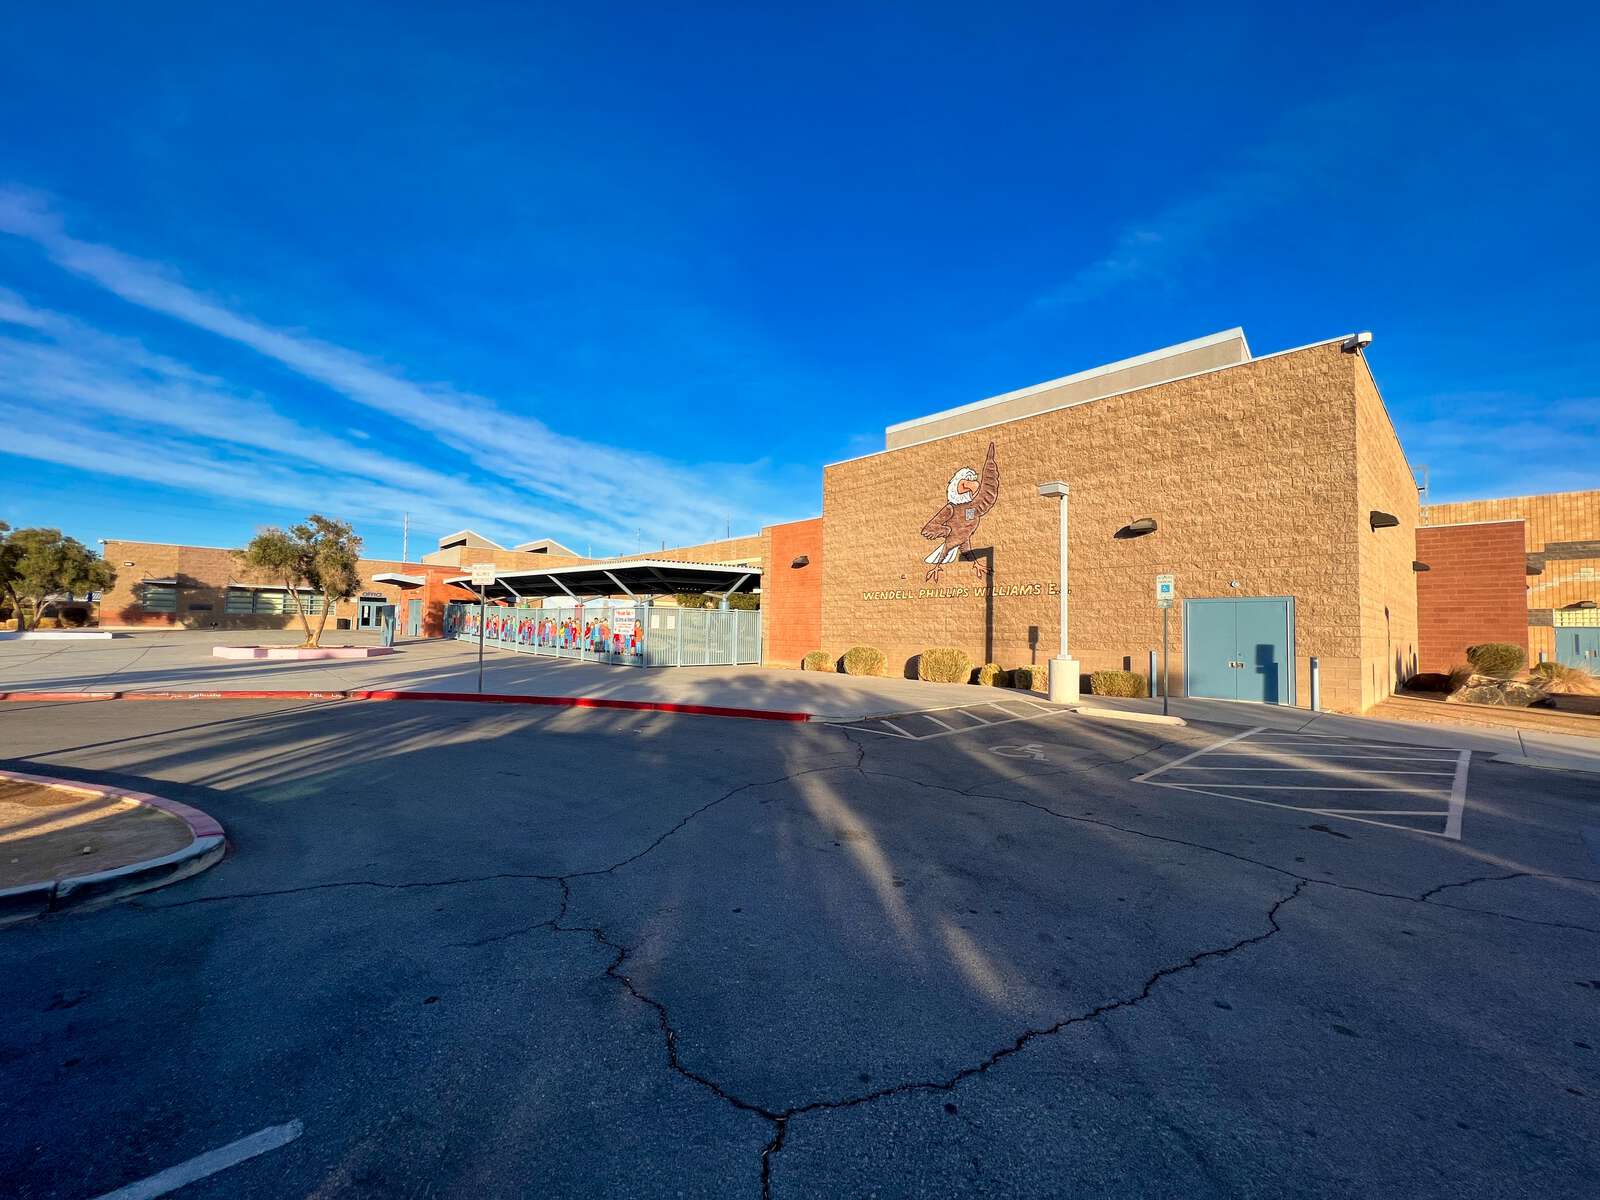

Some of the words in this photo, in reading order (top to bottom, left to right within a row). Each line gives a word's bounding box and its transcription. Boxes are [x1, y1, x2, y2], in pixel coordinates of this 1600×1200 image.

[863, 590, 914, 601] WENDELL
[919, 587, 969, 599] PHILLIPS
[974, 584, 1041, 597] WILLIAMS
